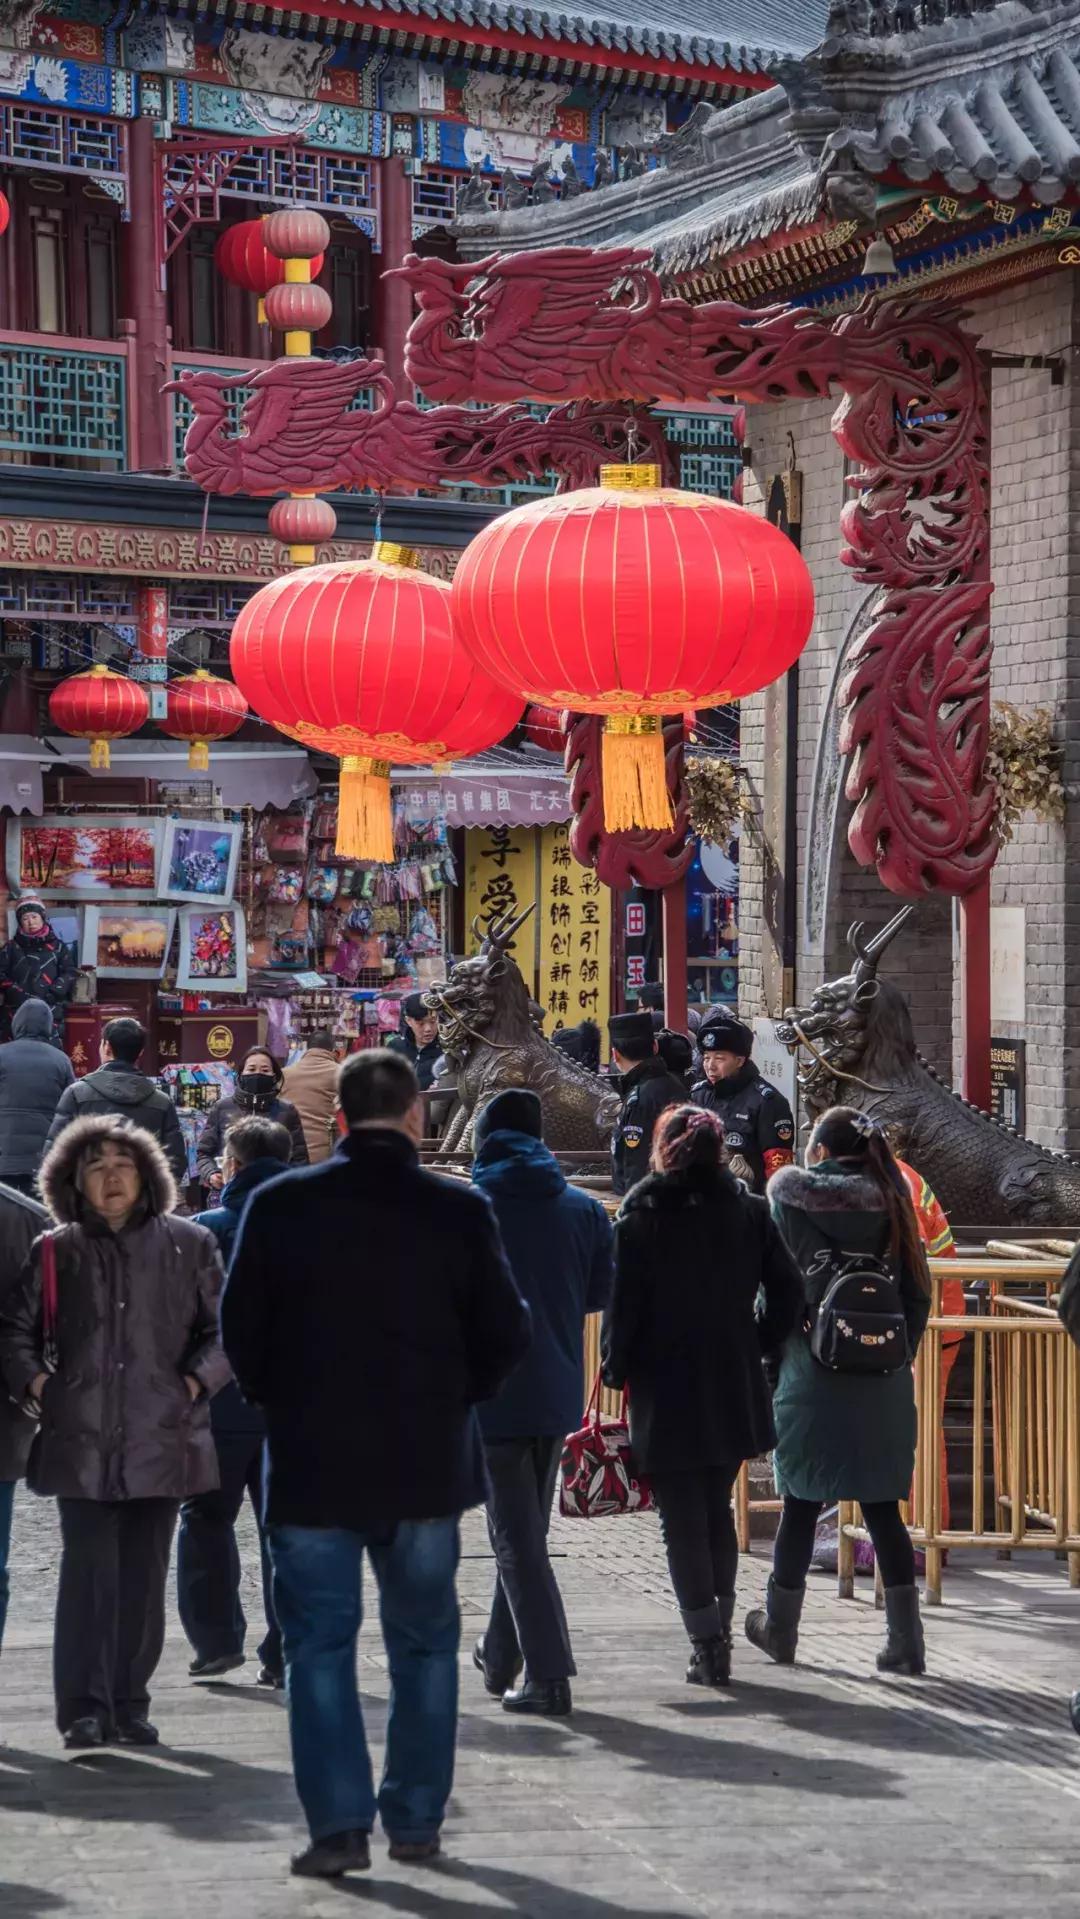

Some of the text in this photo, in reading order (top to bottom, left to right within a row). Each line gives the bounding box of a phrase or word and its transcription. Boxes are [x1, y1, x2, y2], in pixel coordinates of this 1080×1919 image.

[529, 790, 573, 811] 汇天
[479, 823, 521, 964] 享受
[579, 873, 600, 1022] 彩宝引领时
